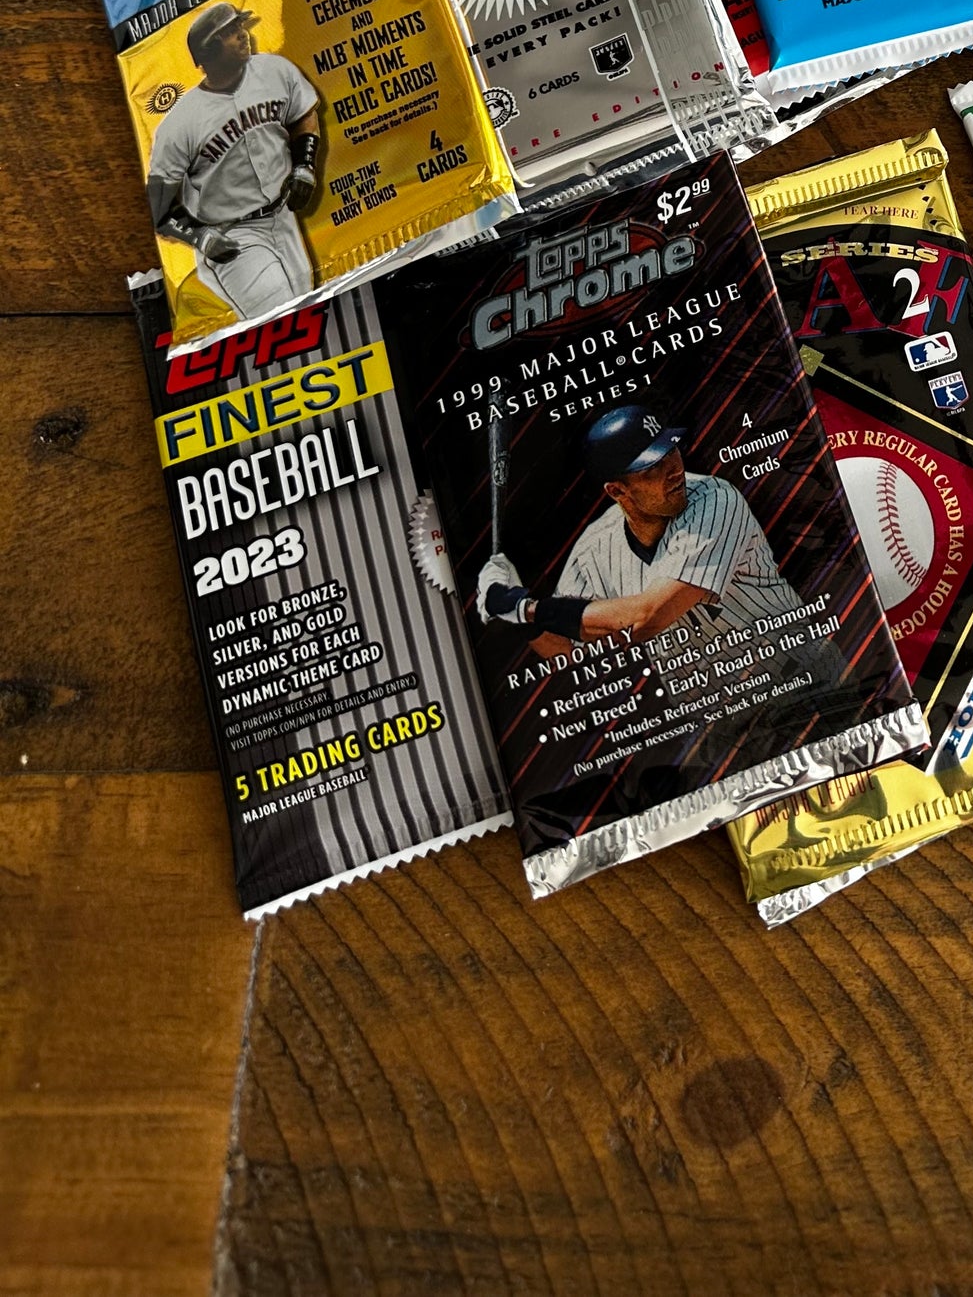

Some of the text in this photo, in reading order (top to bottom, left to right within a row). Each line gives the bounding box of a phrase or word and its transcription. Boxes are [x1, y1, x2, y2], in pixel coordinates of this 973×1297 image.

[350, 11, 426, 57] MOMENTS
[484, 23, 528, 51] SOLID
[531, 6, 573, 30] STEEL
[486, 6, 622, 69] EVERY PACK!
[333, 62, 438, 124] RELIC CARDS!
[528, 72, 581, 99] 6 CARDS
[329, 161, 381, 196] FOUR-TIME
[416, 145, 468, 183] CARDS
[843, 205, 919, 219] TEAR HERE
[780, 242, 939, 266] SERIES
[470, 235, 696, 350] Chrome
[892, 268, 930, 319] 2
[436, 283, 742, 415] 1999 MAJOR LEAGUE
[631, 318, 723, 365] CARDS
[164, 350, 374, 461] FINEST
[550, 374, 652, 423] SERIES 1
[741, 413, 753, 429] 4
[718, 428, 790, 464] Chromium
[742, 457, 781, 480] Cards
[177, 419, 379, 540] BASEBALL
[863, 430, 965, 563] REGULAR CARD HAS
[193, 526, 305, 597] 2023
[213, 607, 345, 666] SILVER, AND GOLD
[217, 626, 360, 690] VERSIONS FOR EACH
[507, 626, 635, 690] RANDOMLY
[572, 625, 702, 685] INSERTED:
[222, 645, 381, 714] DYNAMIC THEME CARD
[552, 675, 633, 716] Refractors
[702, 671, 812, 723] See back for details.)
[236, 704, 443, 801] 5 TRADING CARDS
